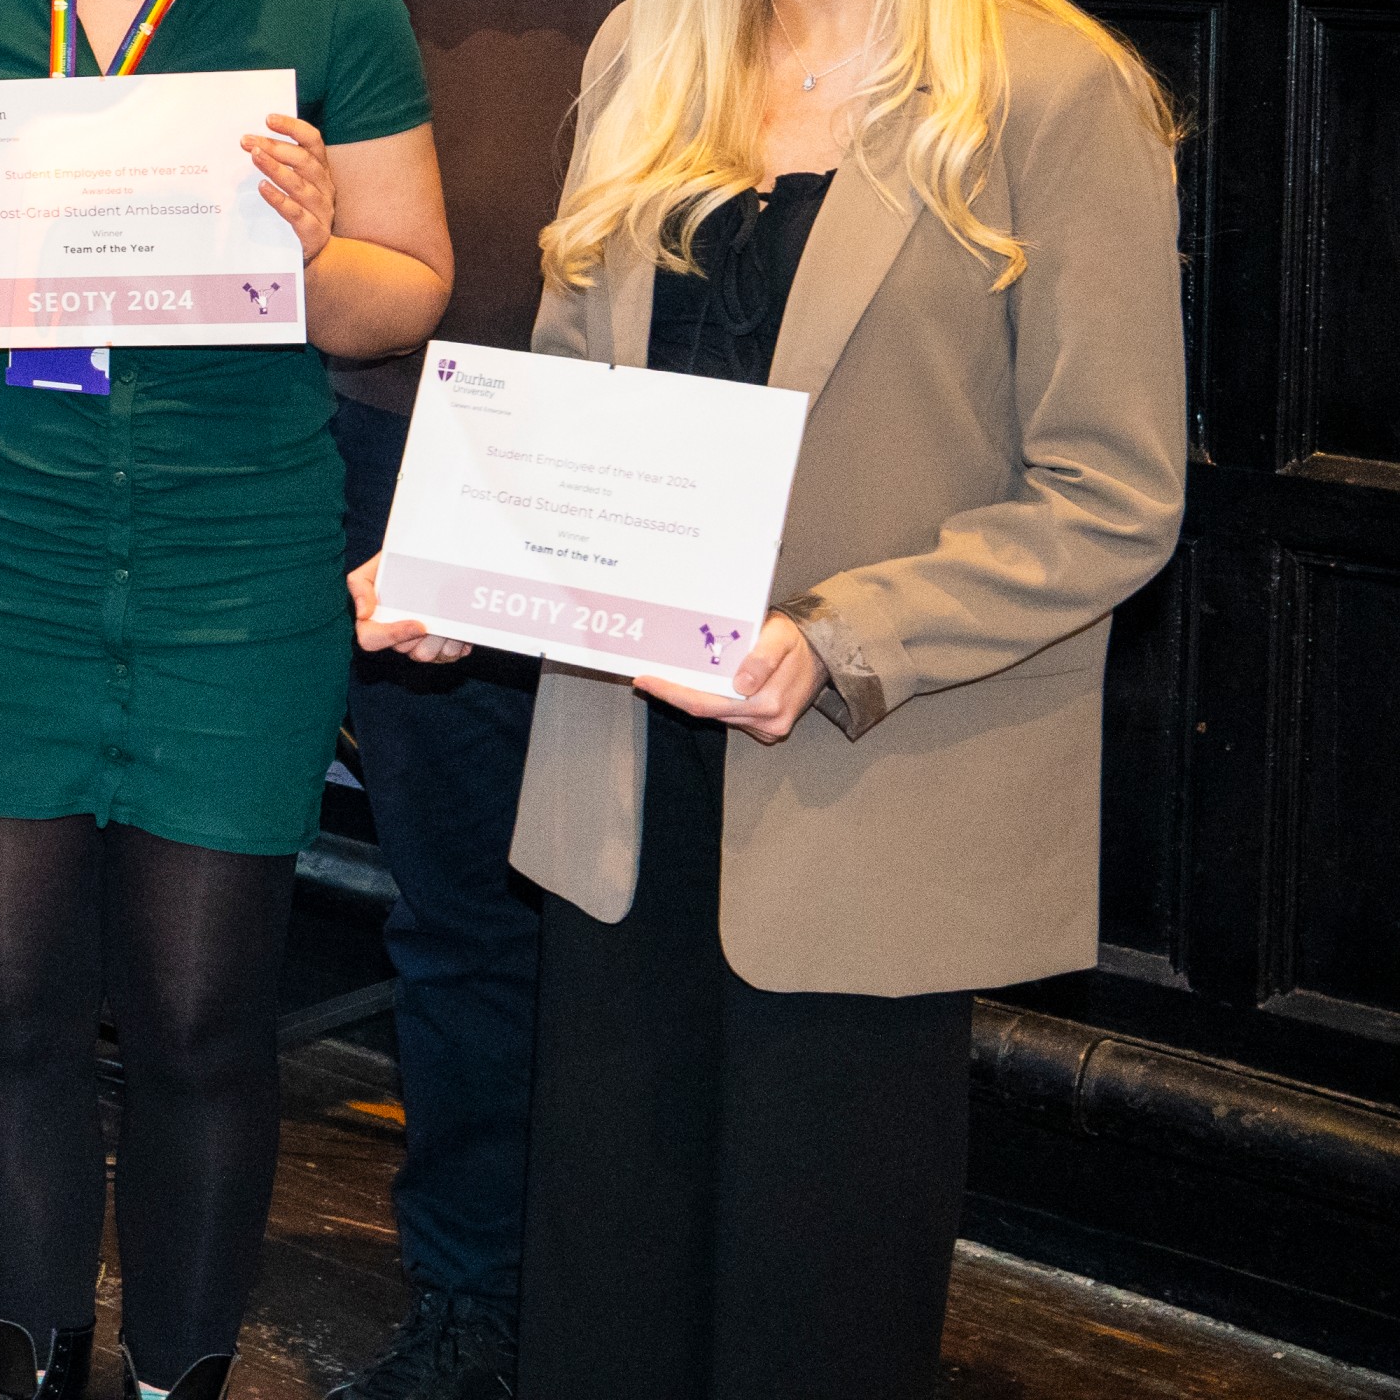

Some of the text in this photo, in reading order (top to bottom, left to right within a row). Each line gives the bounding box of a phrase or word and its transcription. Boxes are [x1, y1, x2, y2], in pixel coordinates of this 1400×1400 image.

[5, 165, 208, 179] Student Employee of the Year 2024
[65, 206, 120, 217] Student
[125, 203, 221, 215] Ambassadors
[96, 245, 106, 253] of
[28, 290, 193, 312] SEOTY 2024
[455, 372, 505, 389] Durham
[454, 386, 494, 399] University
[487, 446, 696, 488] Student Employee of the Year 2024
[559, 481, 600, 494] Awarded
[461, 485, 699, 537] Post-Grad Student Ambassadors
[558, 530, 590, 542] Winner
[525, 541, 618, 566] Team of the Year
[472, 587, 643, 641] SEOTY 2024
